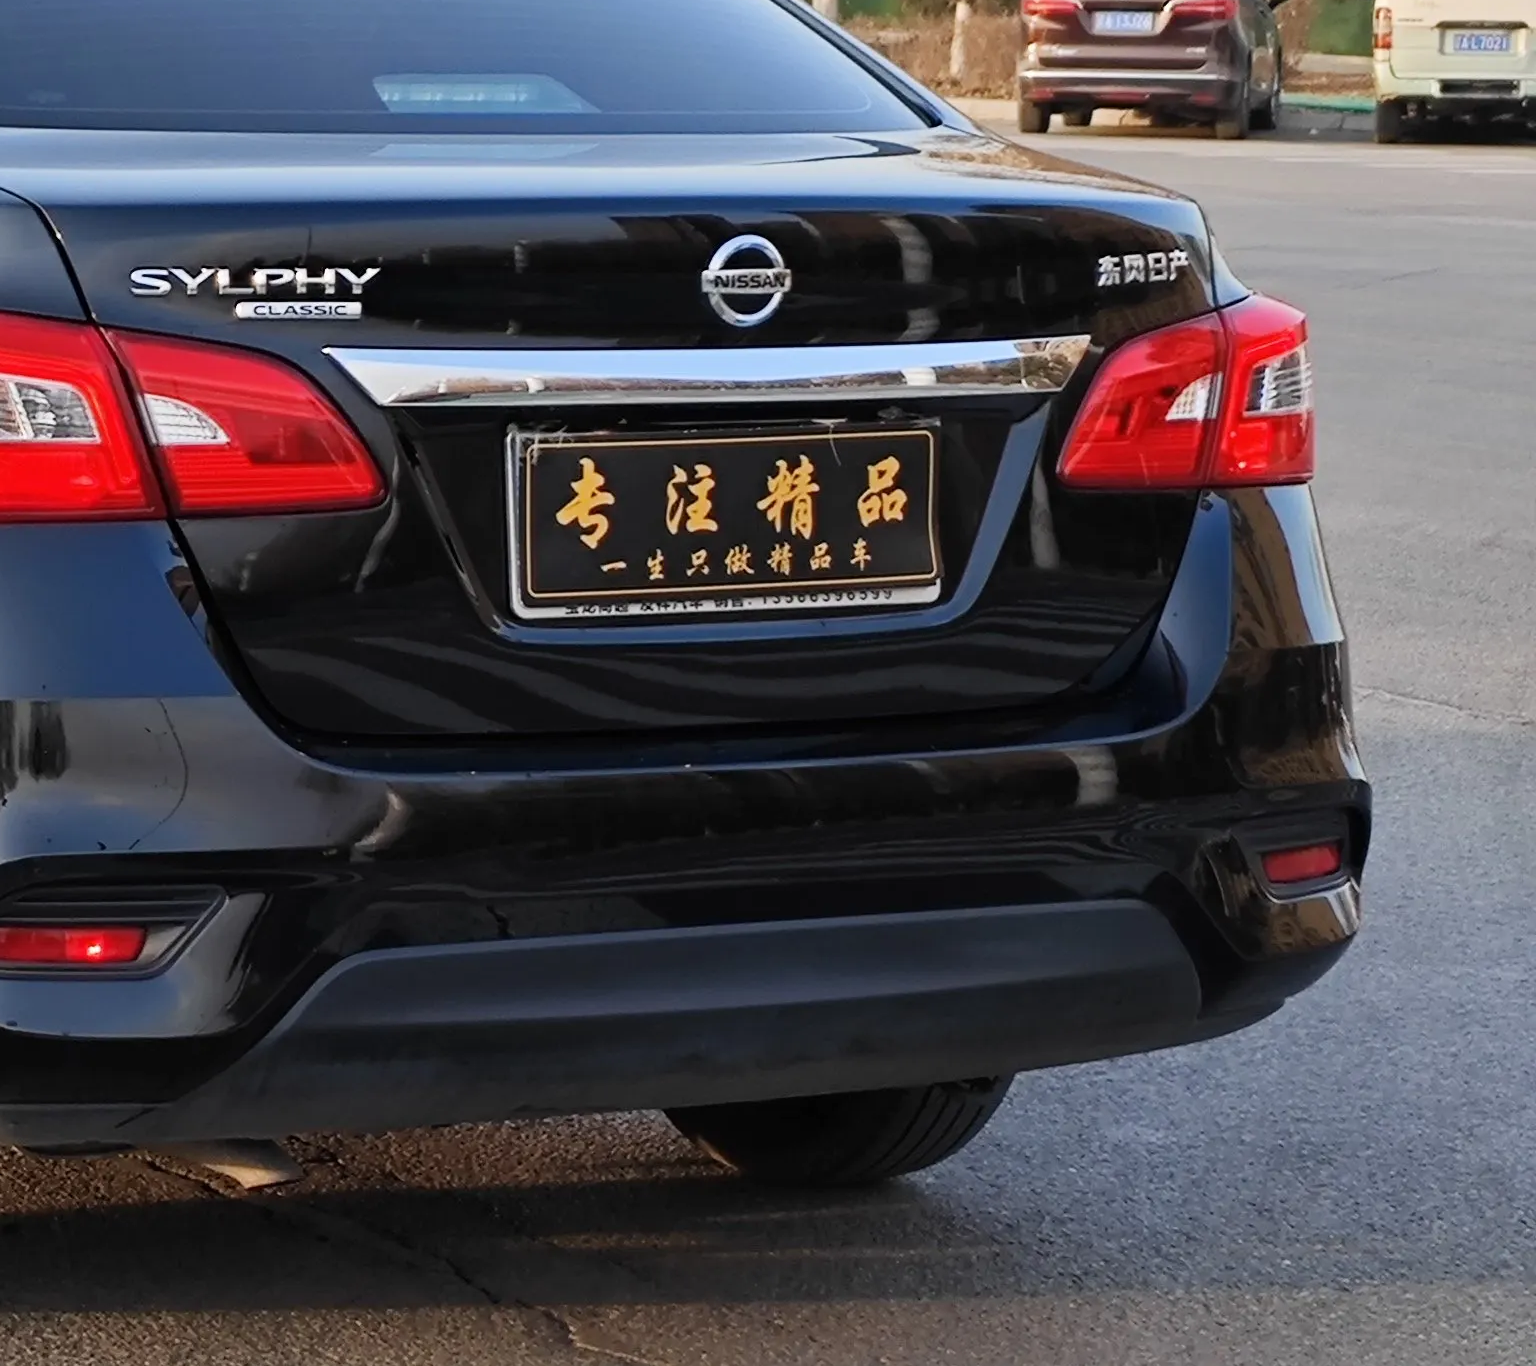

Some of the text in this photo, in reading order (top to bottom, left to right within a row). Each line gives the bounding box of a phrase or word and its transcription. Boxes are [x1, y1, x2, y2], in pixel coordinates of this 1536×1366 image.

[130, 266, 381, 296] SYLPHY
[713, 272, 786, 289] NISSAN
[1097, 249, 1189, 287] 东风日产
[252, 304, 348, 317] CLASSIC
[555, 454, 908, 550] 专注精品
[599, 537, 873, 581] 一生只做精品车
